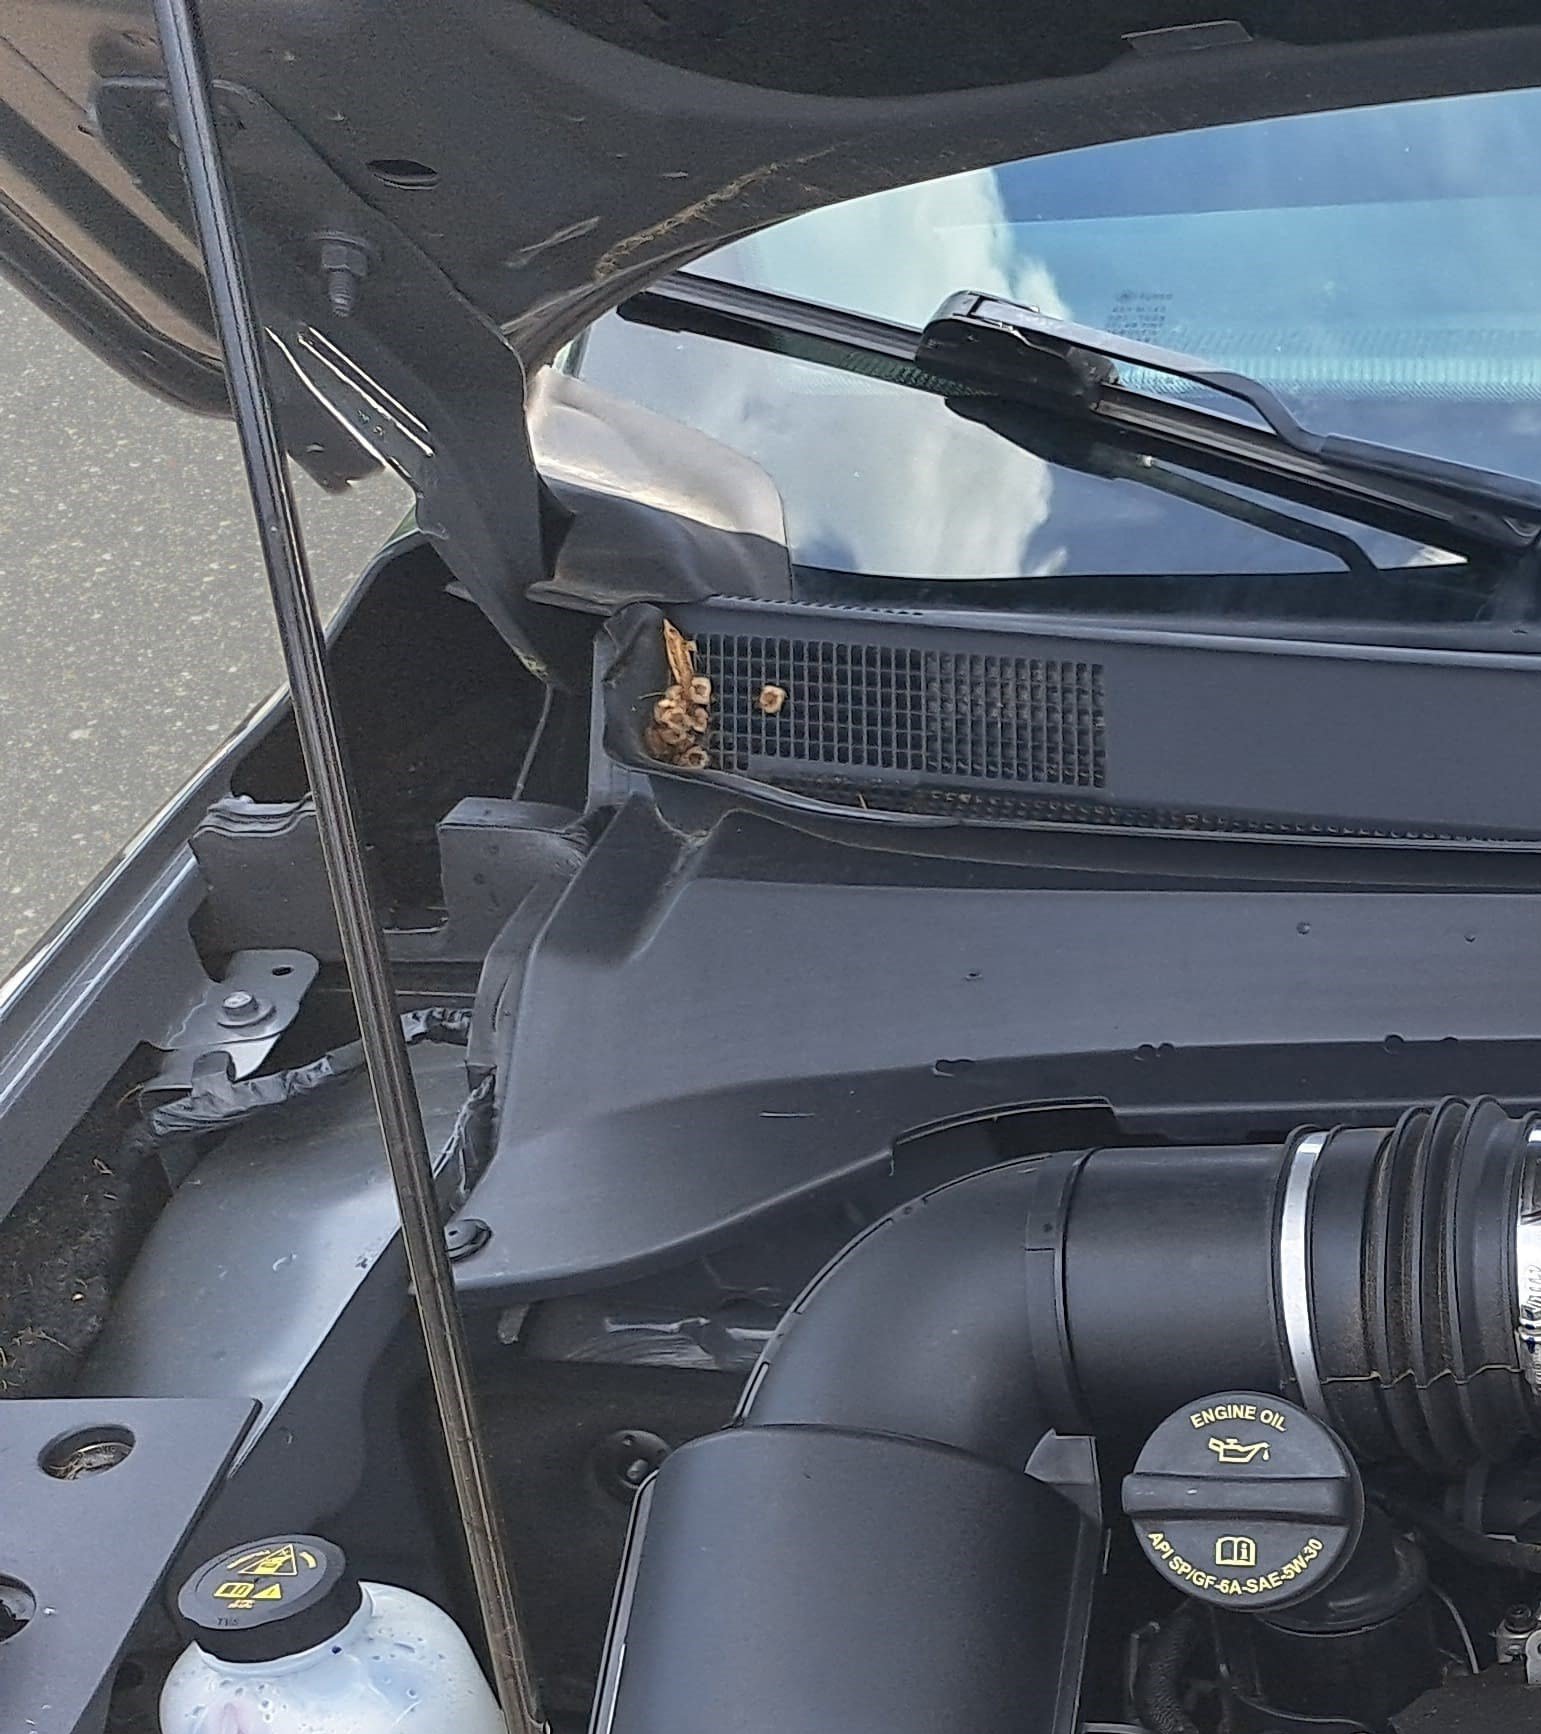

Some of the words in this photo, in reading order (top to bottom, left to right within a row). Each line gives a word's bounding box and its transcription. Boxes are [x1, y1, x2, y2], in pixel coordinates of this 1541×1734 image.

[1189, 1403, 1257, 1430] ENGINE
[1259, 1408, 1289, 1433] OIL
[1148, 1531, 1173, 1560] API
